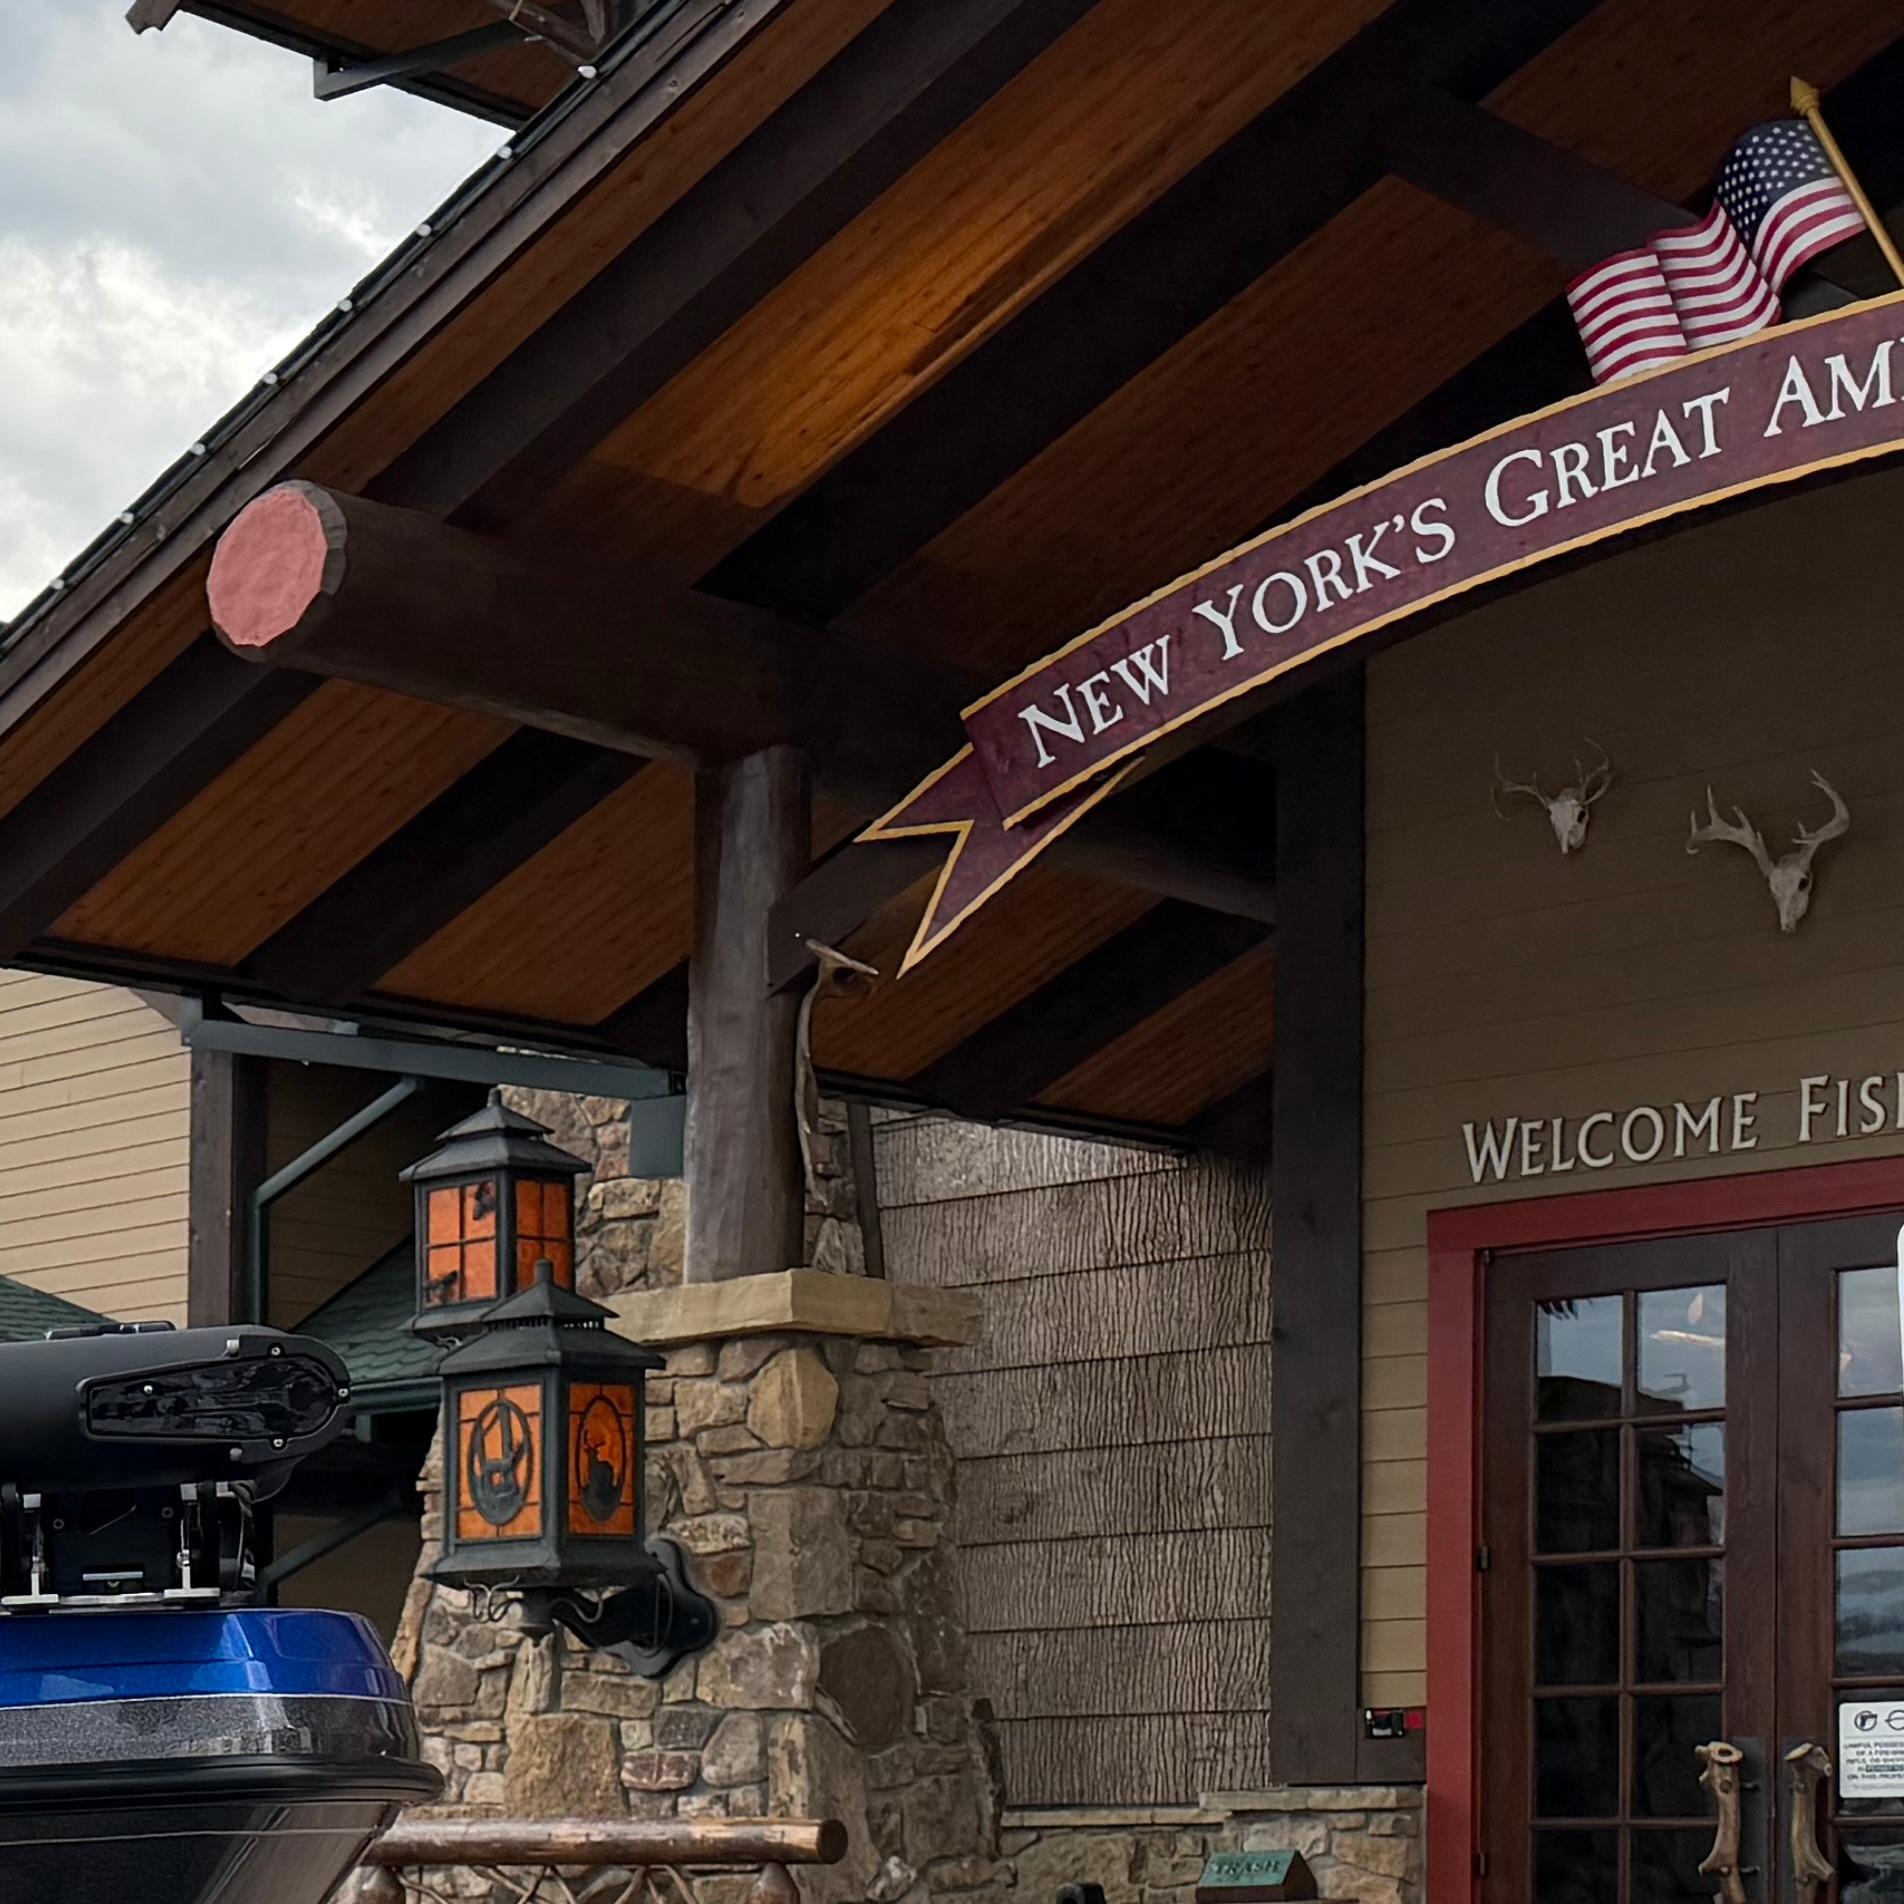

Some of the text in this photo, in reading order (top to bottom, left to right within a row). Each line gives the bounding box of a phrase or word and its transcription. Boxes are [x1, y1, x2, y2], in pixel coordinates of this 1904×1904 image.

[1019, 337, 1904, 770] NEW YORK'S GREAT AM
[1462, 1091, 1759, 1183] WELCOME
[1212, 1860, 1280, 1877] TRASH
